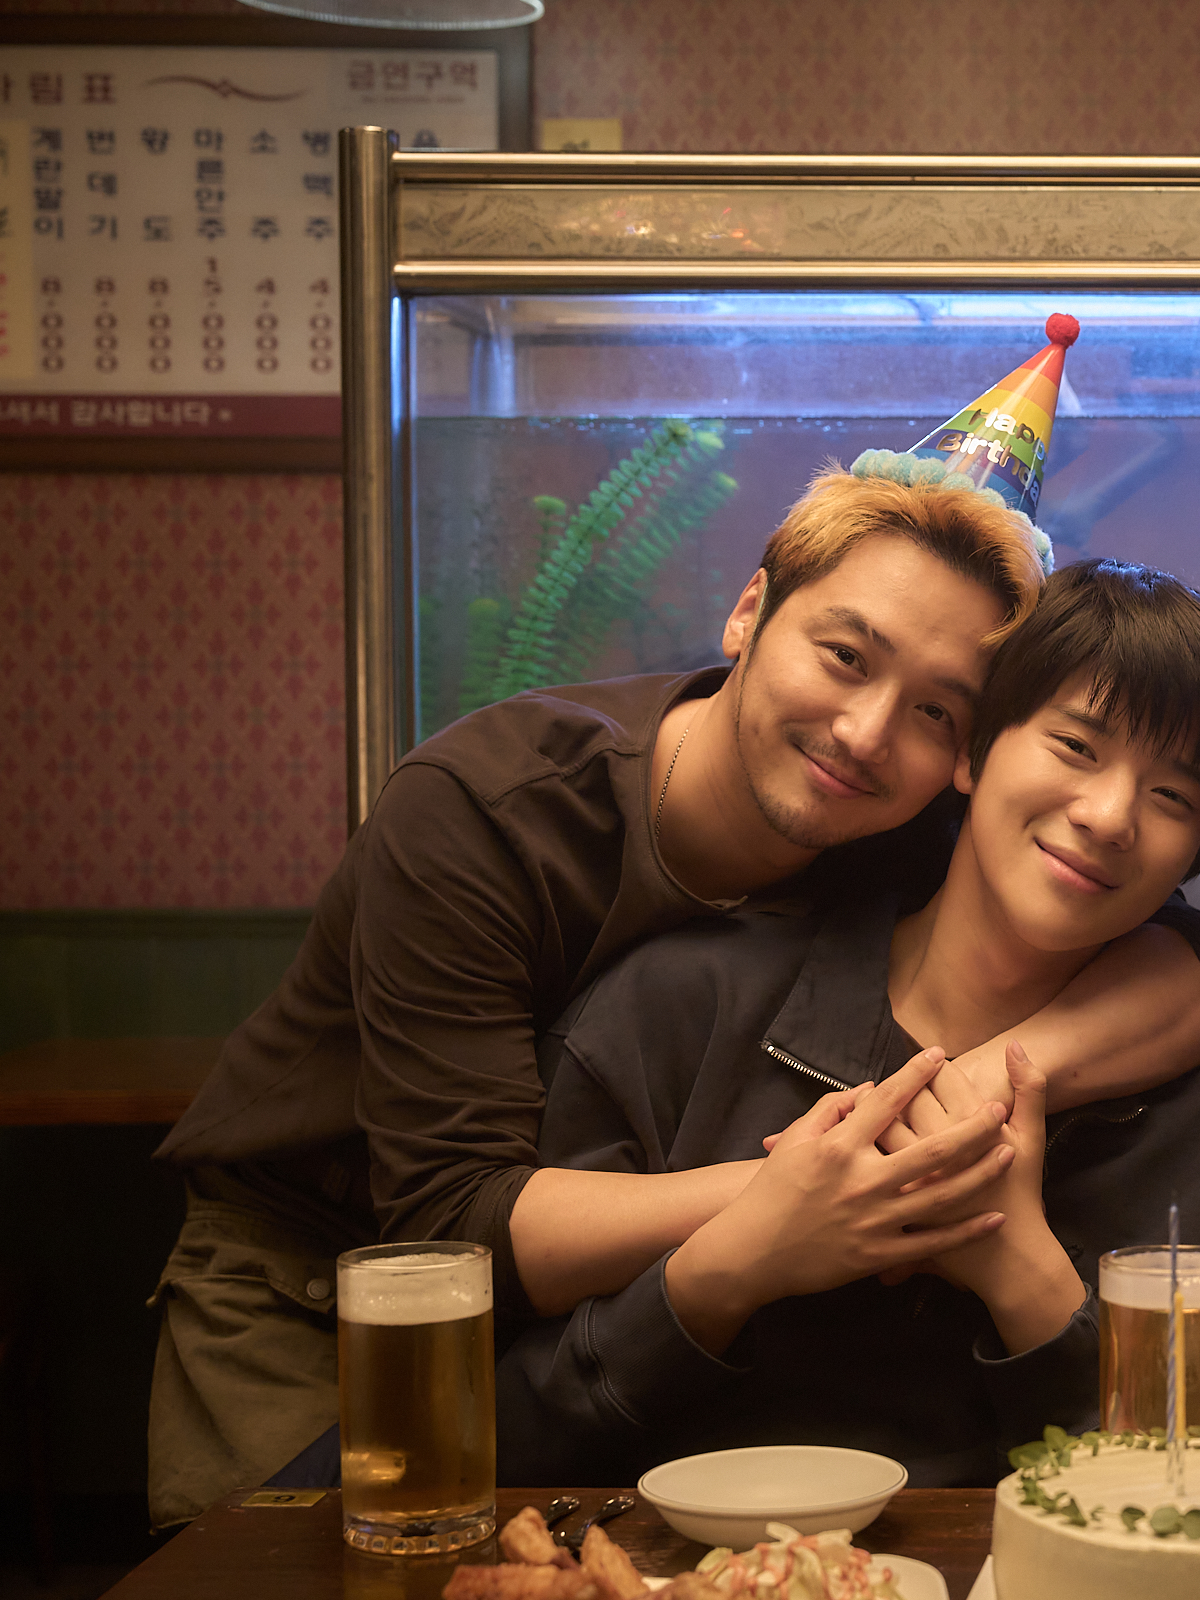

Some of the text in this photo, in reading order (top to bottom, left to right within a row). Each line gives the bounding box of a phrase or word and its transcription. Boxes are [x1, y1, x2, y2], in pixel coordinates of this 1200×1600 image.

[348, 59, 479, 90] 금연구역
[86, 129, 118, 241] 번데기
[194, 128, 226, 241] 마른안주
[250, 128, 280, 241] 소주
[71, 401, 211, 427] 감사합니다
[936, 432, 1040, 508] Birthda
